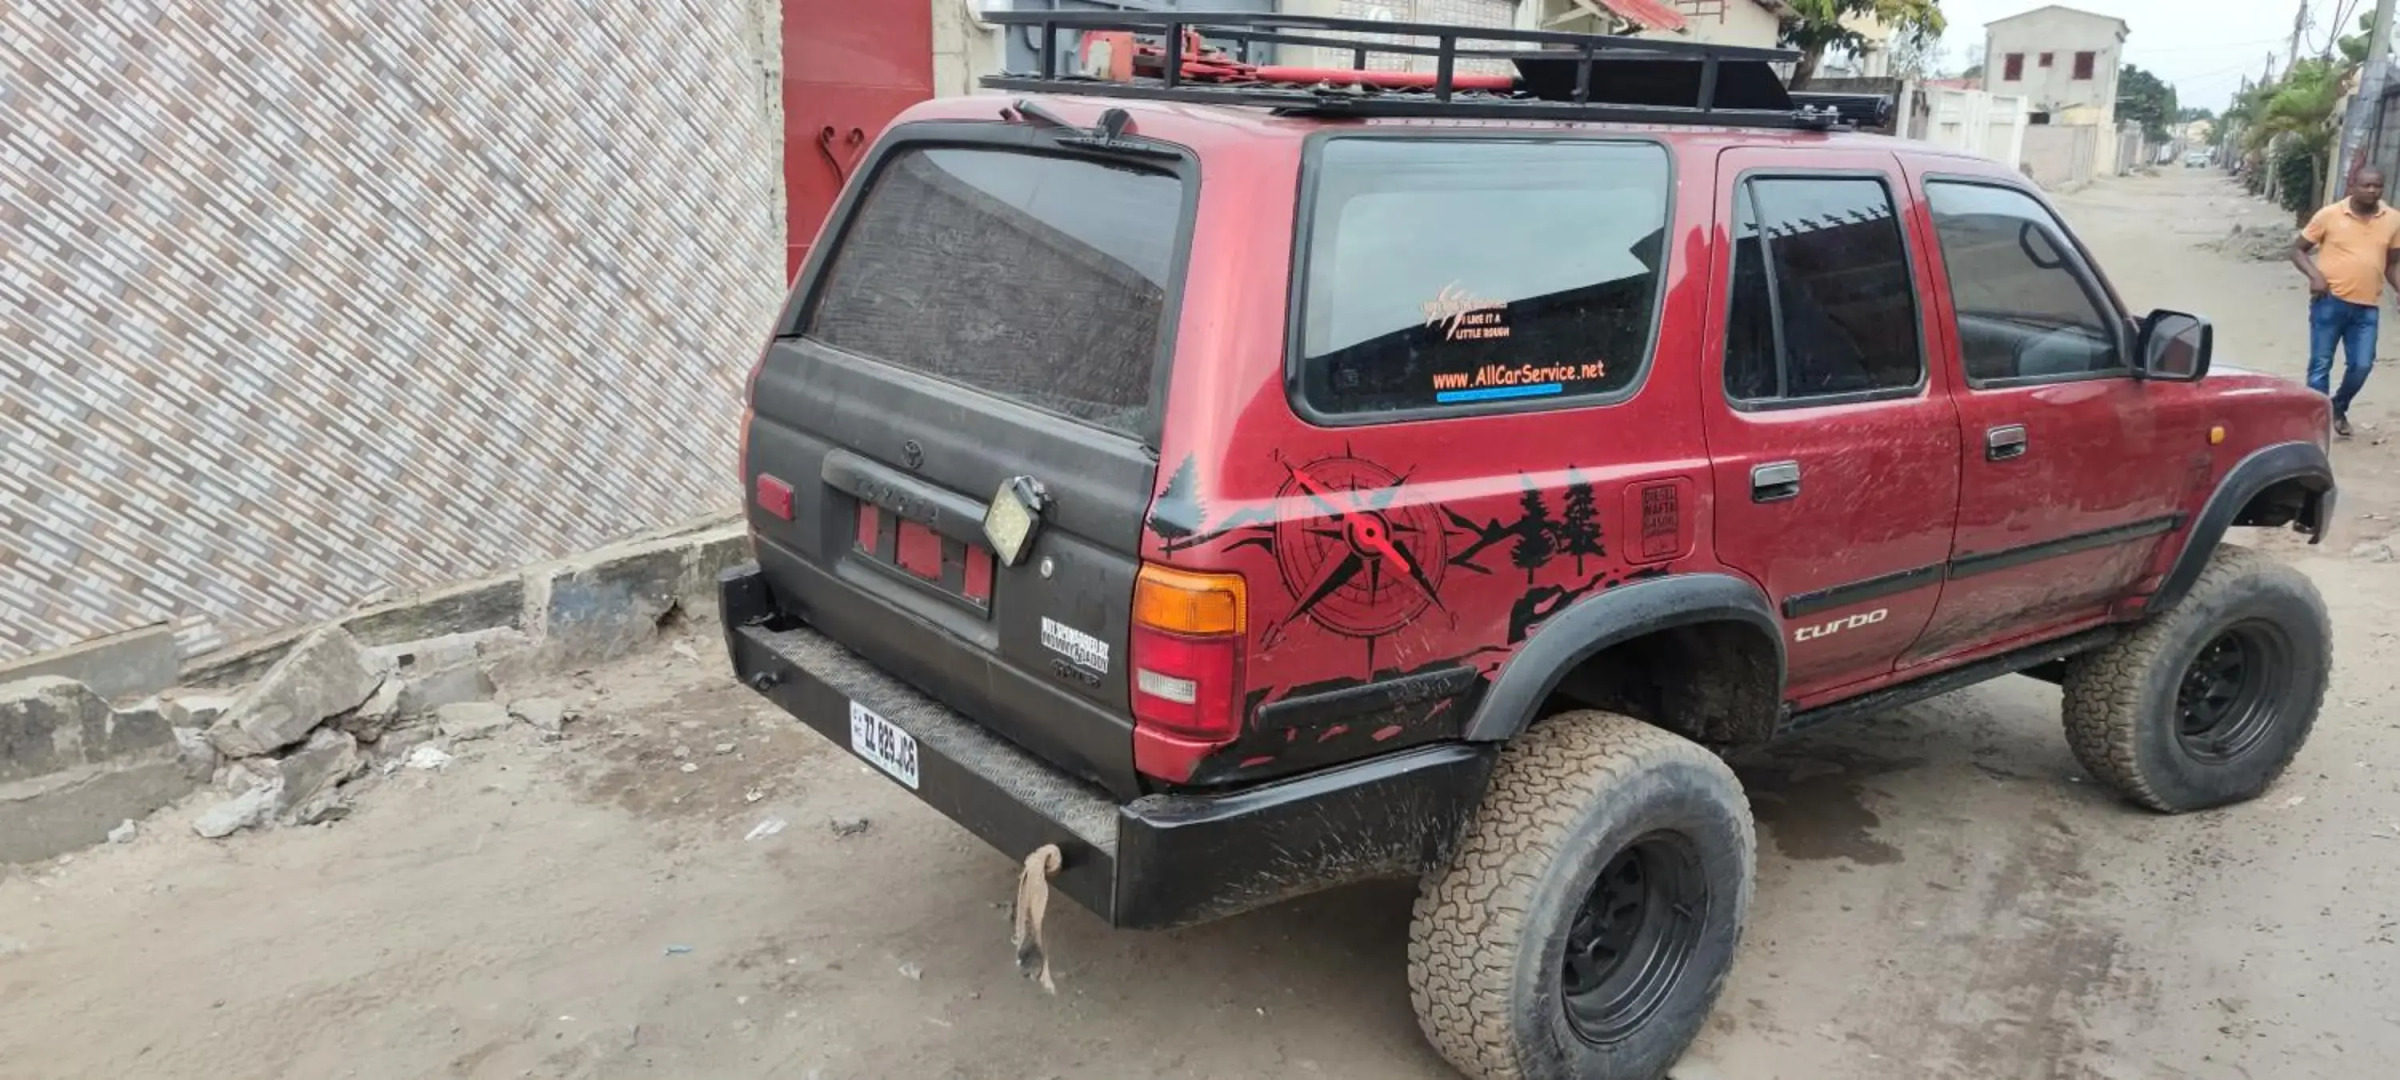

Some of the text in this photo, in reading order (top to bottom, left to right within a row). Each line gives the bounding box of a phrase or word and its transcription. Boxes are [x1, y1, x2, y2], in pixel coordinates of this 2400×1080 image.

[1467, 314, 1484, 325] LIKE
[1485, 313, 1494, 324] IT
[1494, 313, 1502, 323] A
[1456, 326, 1510, 339] LITTLE ROUGH
[1433, 359, 1605, 389] www.AllCarService.net
[878, 720, 895, 764] 829
